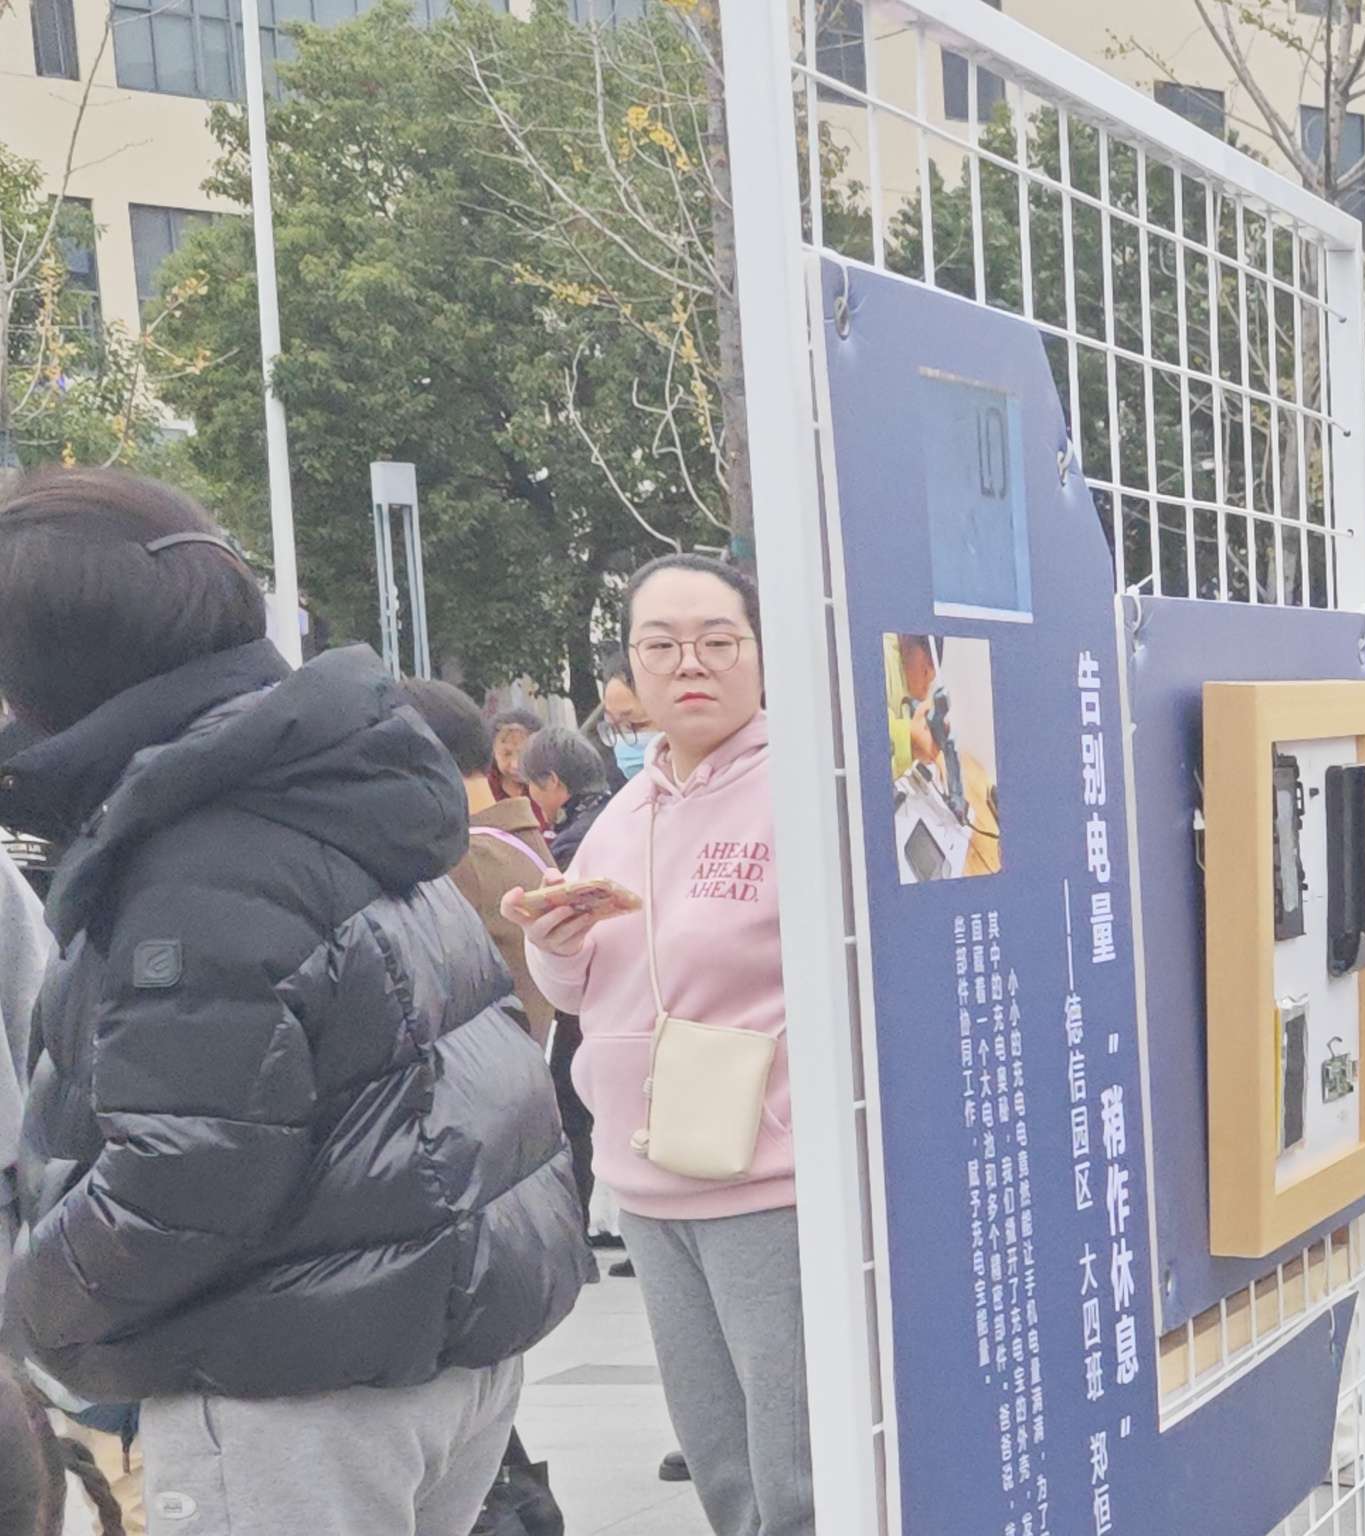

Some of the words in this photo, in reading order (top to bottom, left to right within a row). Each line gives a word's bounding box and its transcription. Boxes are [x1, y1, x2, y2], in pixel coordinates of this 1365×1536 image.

[697, 841, 770, 861] AHEAD.
[691, 861, 764, 882] AHEAD.
[685, 882, 759, 902] AHEAD.
[1079, 1242, 1105, 1402] 大四班
